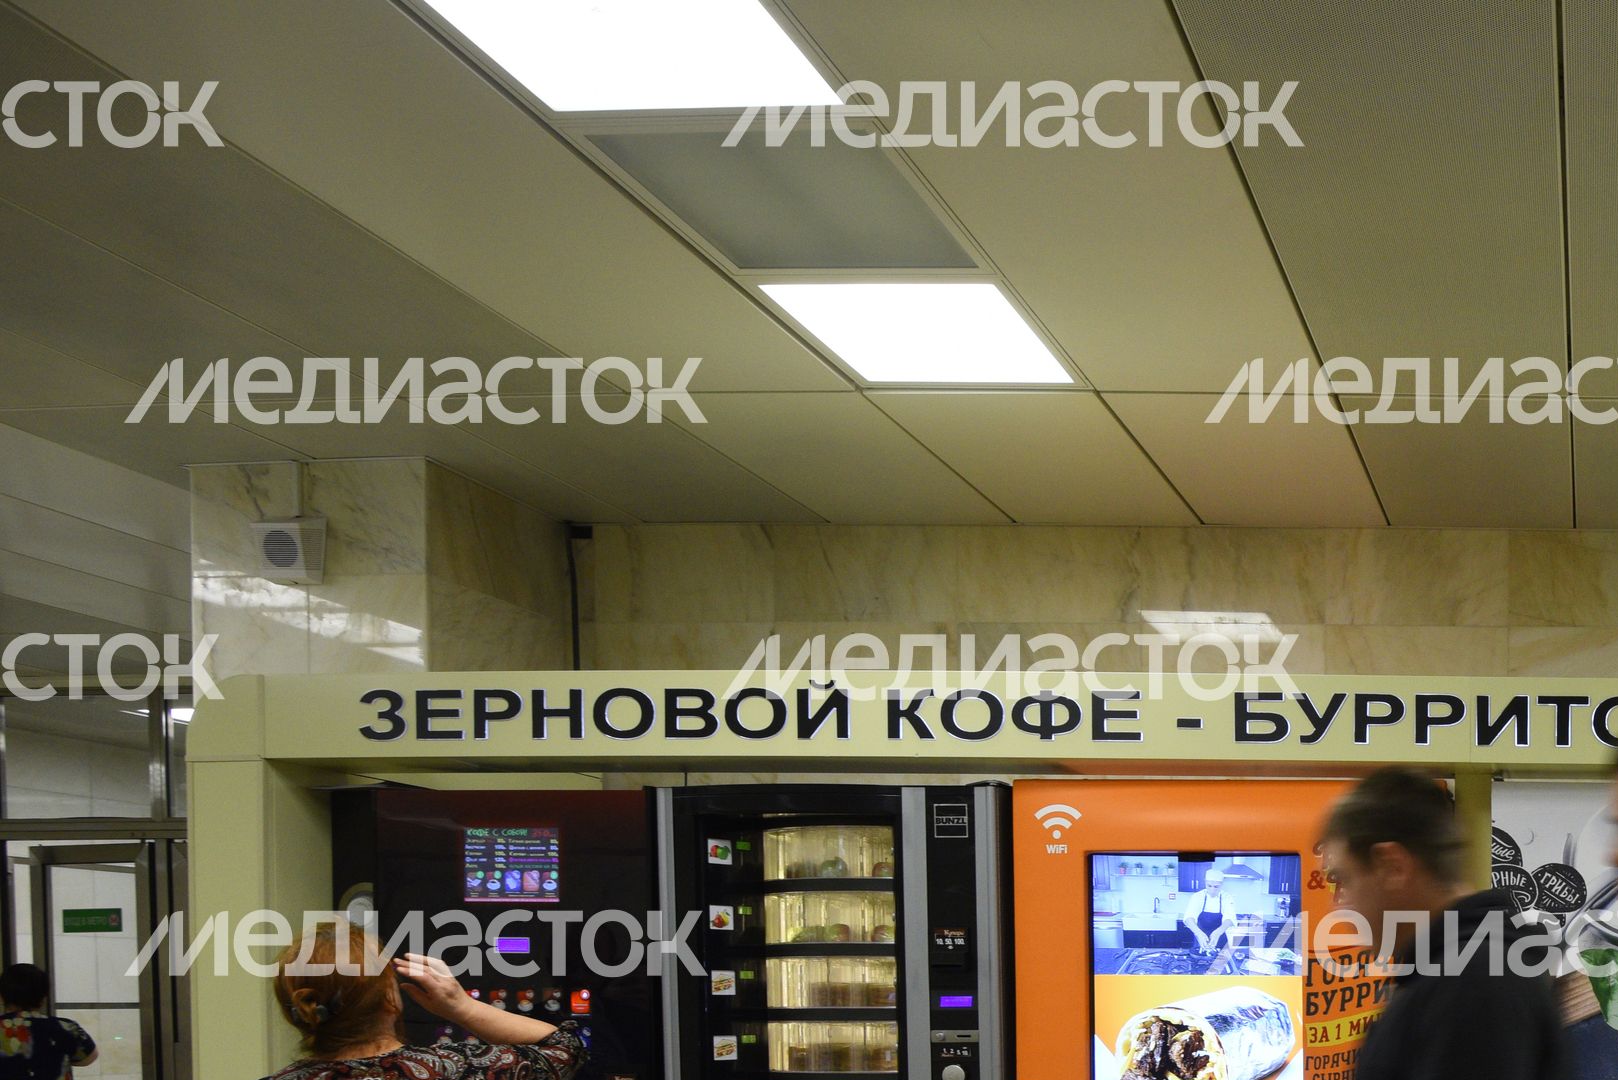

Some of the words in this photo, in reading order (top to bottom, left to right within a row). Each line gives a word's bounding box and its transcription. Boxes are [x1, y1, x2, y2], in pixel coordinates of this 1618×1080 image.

[358, 680, 850, 742] ЗЕРНОВОЙ
[886, 688, 1144, 742] КОФЕ
[936, 817, 967, 825] BUNZL
[1045, 844, 1068, 854] WiFi
[1540, 871, 1580, 905] ГРИБЫ
[1305, 976, 1393, 1017] БУРРИ
[1309, 1025, 1330, 1044] ЗА
